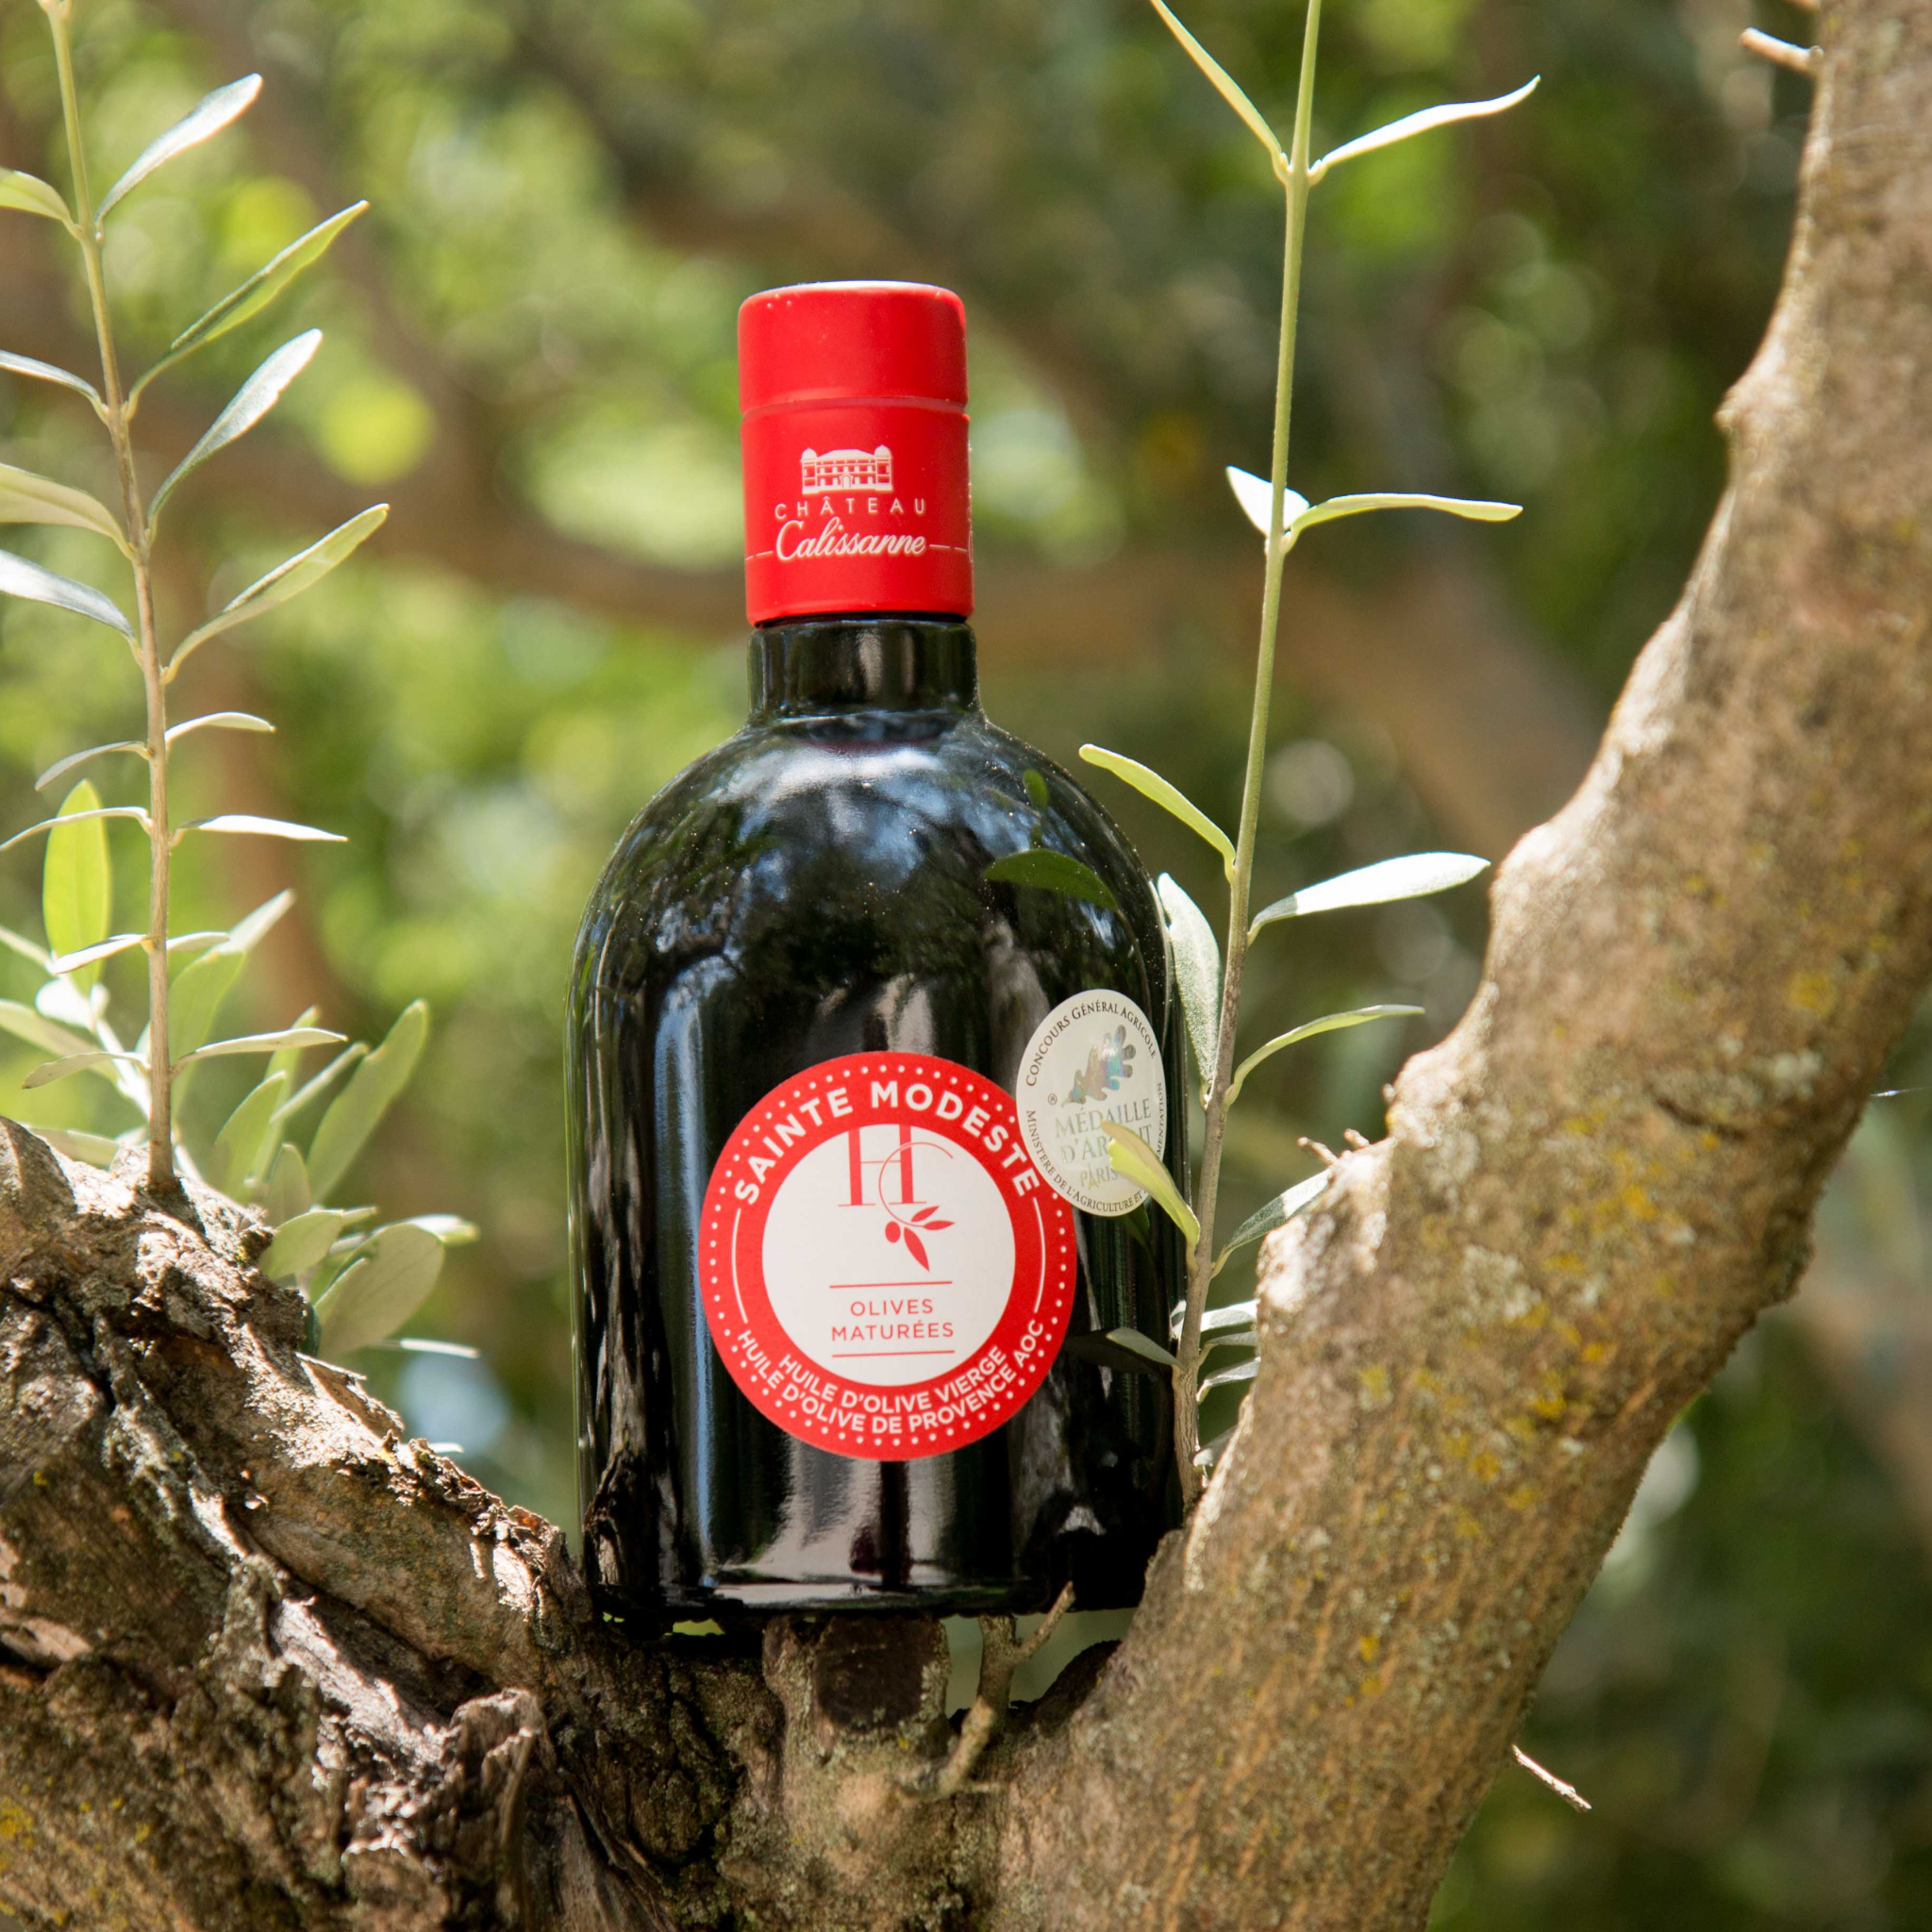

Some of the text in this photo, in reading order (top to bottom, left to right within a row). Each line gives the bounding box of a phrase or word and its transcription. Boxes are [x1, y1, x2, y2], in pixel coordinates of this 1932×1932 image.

[774, 495, 925, 519] CHÂTEAU
[775, 516, 926, 560] Calissanne
[1025, 999, 1157, 1087] CONCOURS GÉNÉRAL AGRICOLE
[734, 1080, 1041, 1205] SAINTE MODESTE
[1055, 1098, 1151, 1138] MÉDAILLE
[1025, 1109, 1056, 1176] MINISTERE
[1053, 1174, 1068, 1190] DE
[1066, 1186, 1135, 1211] L'AGRICULTURE
[1134, 1190, 1143, 1203] ET
[831, 1320, 955, 1341] MATURÉES
[850, 1298, 934, 1317] OLIVES
[737, 1320, 1043, 1434] HUILE D'OLIVE DE PROVENCE AOC
[778, 1345, 1007, 1414] HUILE D'OLIVE VIERGE
